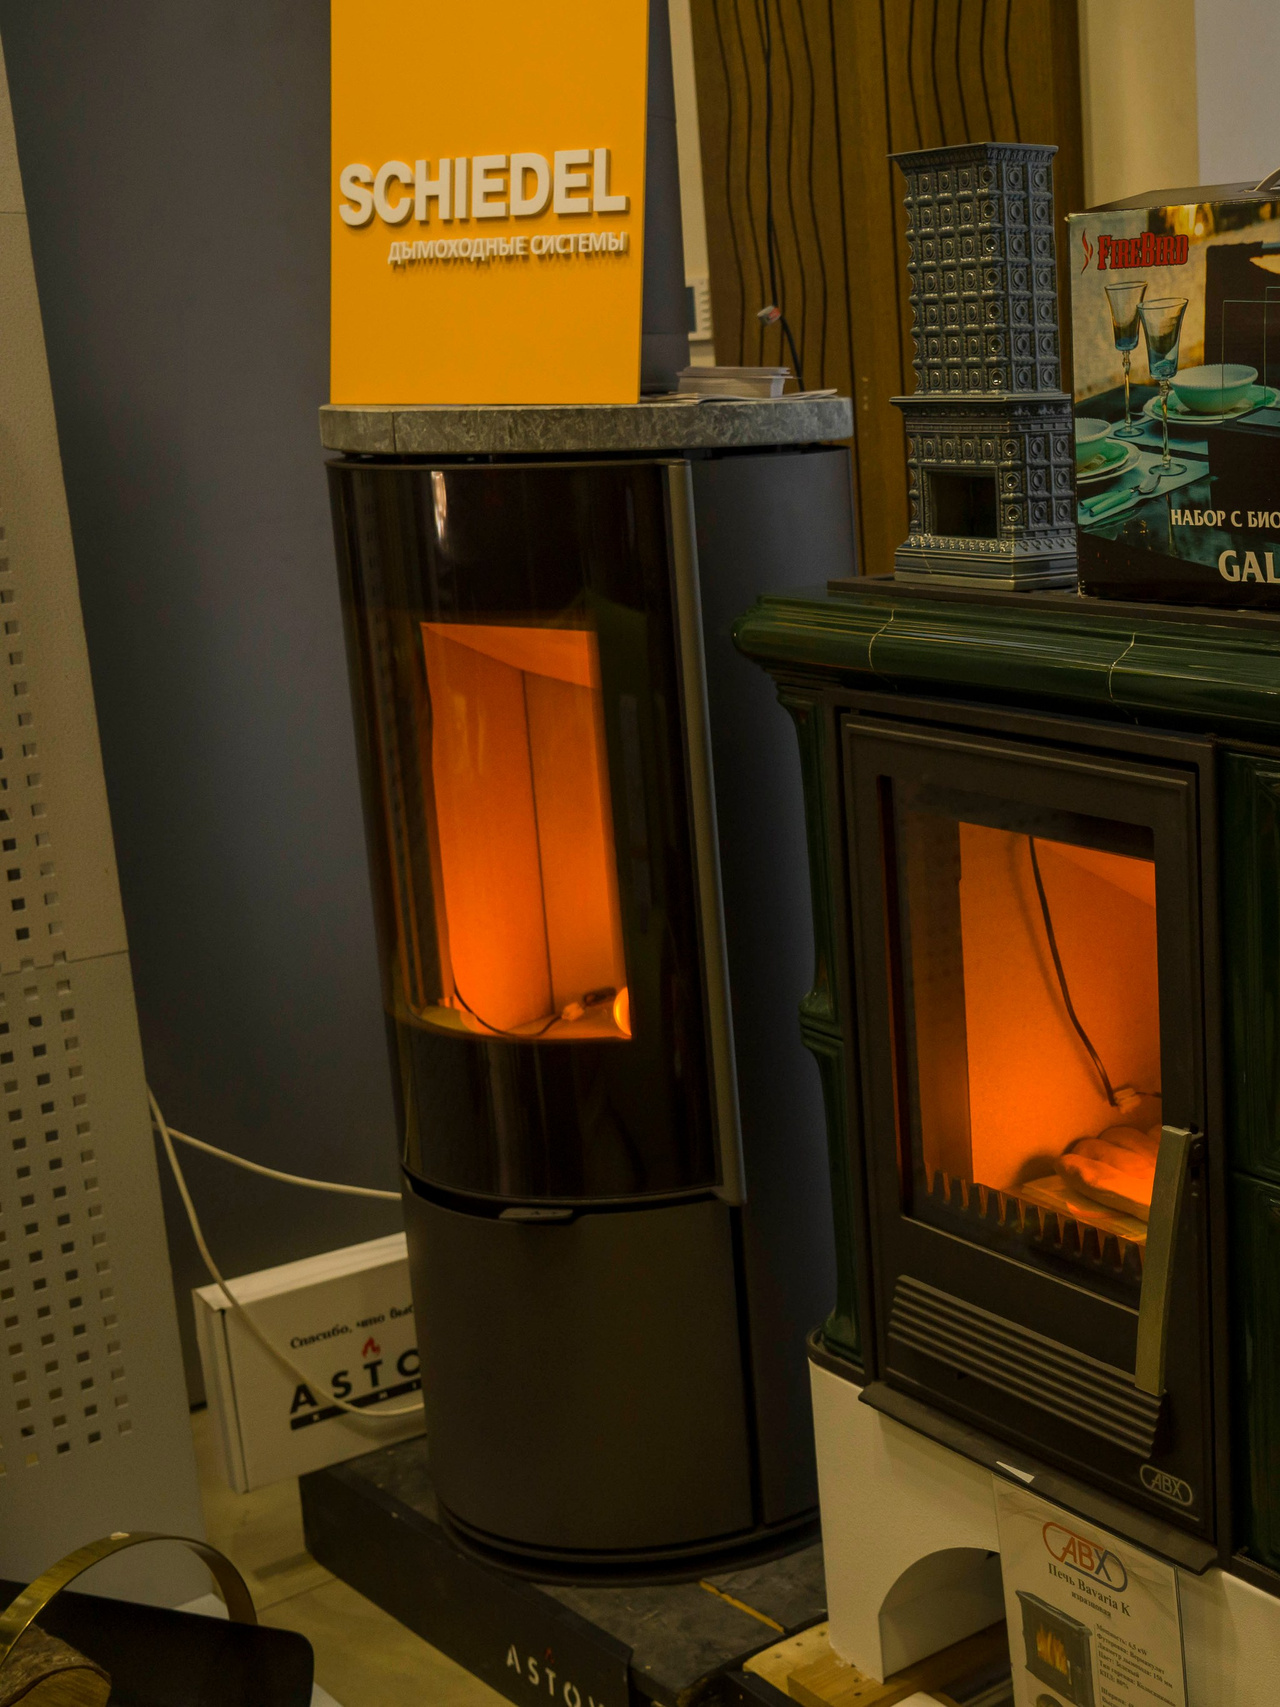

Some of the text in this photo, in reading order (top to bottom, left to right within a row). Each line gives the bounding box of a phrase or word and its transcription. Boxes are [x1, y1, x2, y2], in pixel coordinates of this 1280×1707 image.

[339, 147, 630, 227] SCHIEDEL
[388, 231, 628, 265] ДЫМОХОДНЫЕ СИСТЕМЫ
[1170, 508, 1227, 528] НАБОР
[1230, 509, 1243, 528] С
[290, 1323, 353, 1349] Спасибо,
[356, 1313, 386, 1329] что
[1048, 1562, 1131, 1617] Печь Bavaria K
